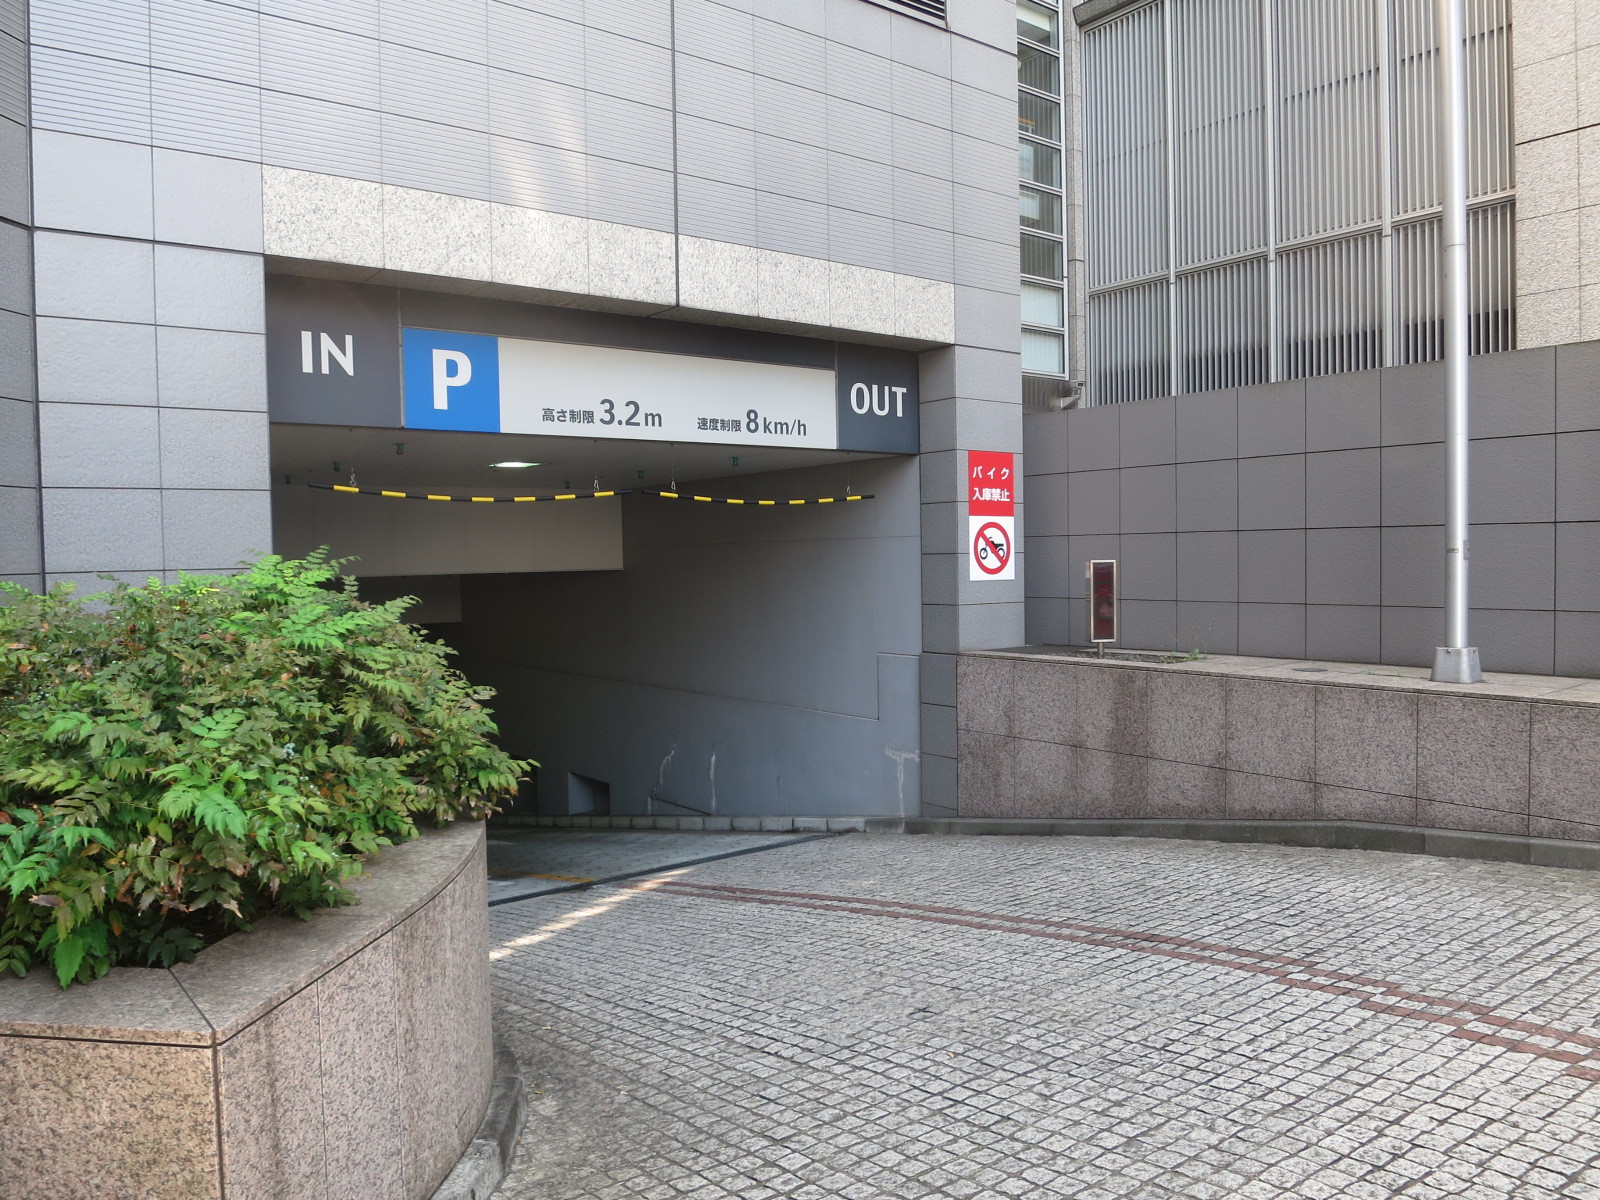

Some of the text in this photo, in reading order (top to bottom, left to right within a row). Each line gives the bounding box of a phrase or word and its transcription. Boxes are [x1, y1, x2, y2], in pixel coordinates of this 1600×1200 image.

[301, 330, 354, 376] IN
[432, 348, 472, 410] P
[850, 382, 907, 418] OUT
[542, 408, 595, 424] 高さ制限
[697, 417, 742, 433] 速度制限
[972, 465, 1010, 480] バイク
[972, 487, 1011, 502] 入庫禁止
